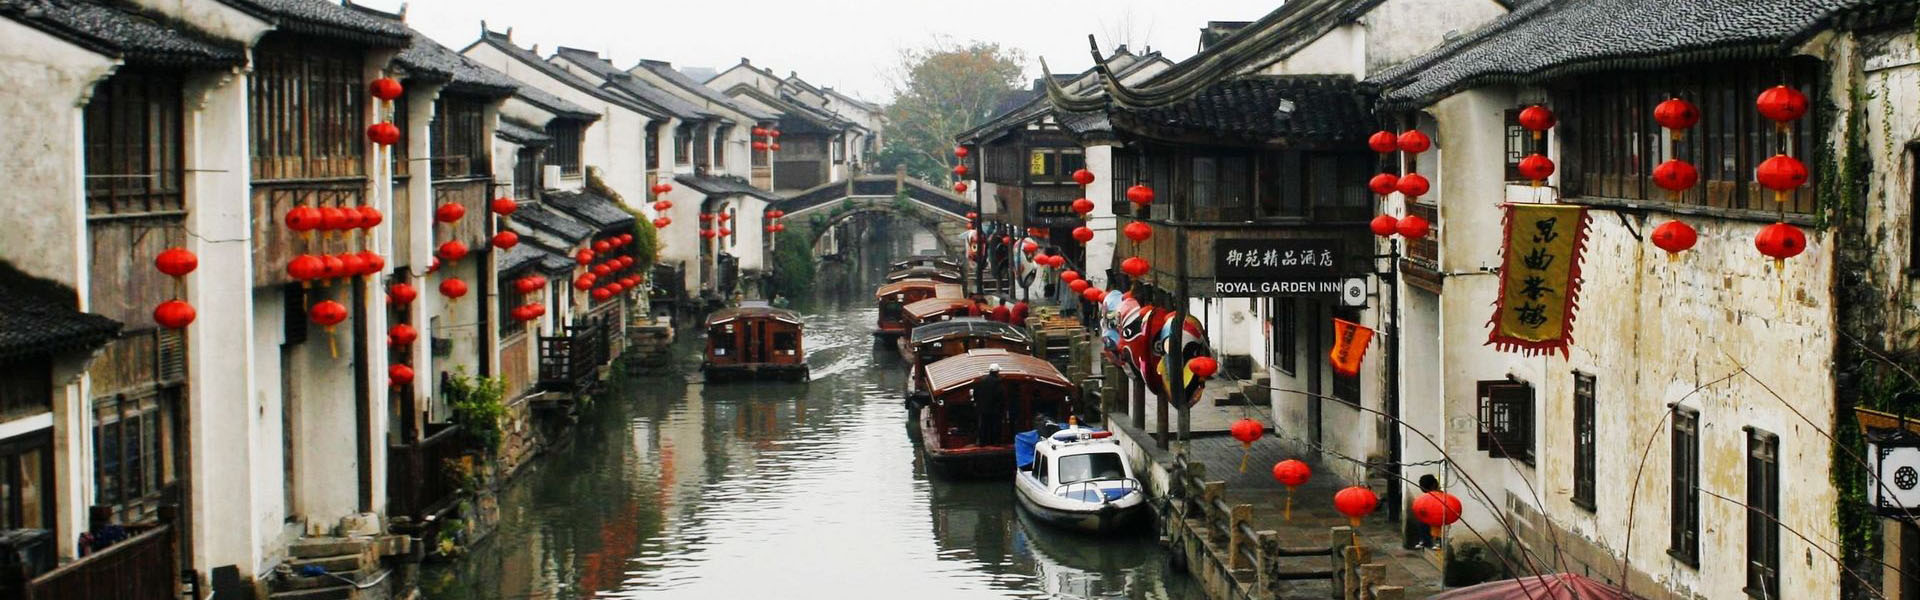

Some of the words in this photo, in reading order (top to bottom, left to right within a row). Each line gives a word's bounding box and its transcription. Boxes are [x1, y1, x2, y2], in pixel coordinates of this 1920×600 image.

[1226, 249, 1333, 268] 御苑精品酒店
[1216, 282, 1257, 293] ROYAL
[1261, 281, 1316, 293] GARDEN
[1320, 281, 1341, 293] INN
